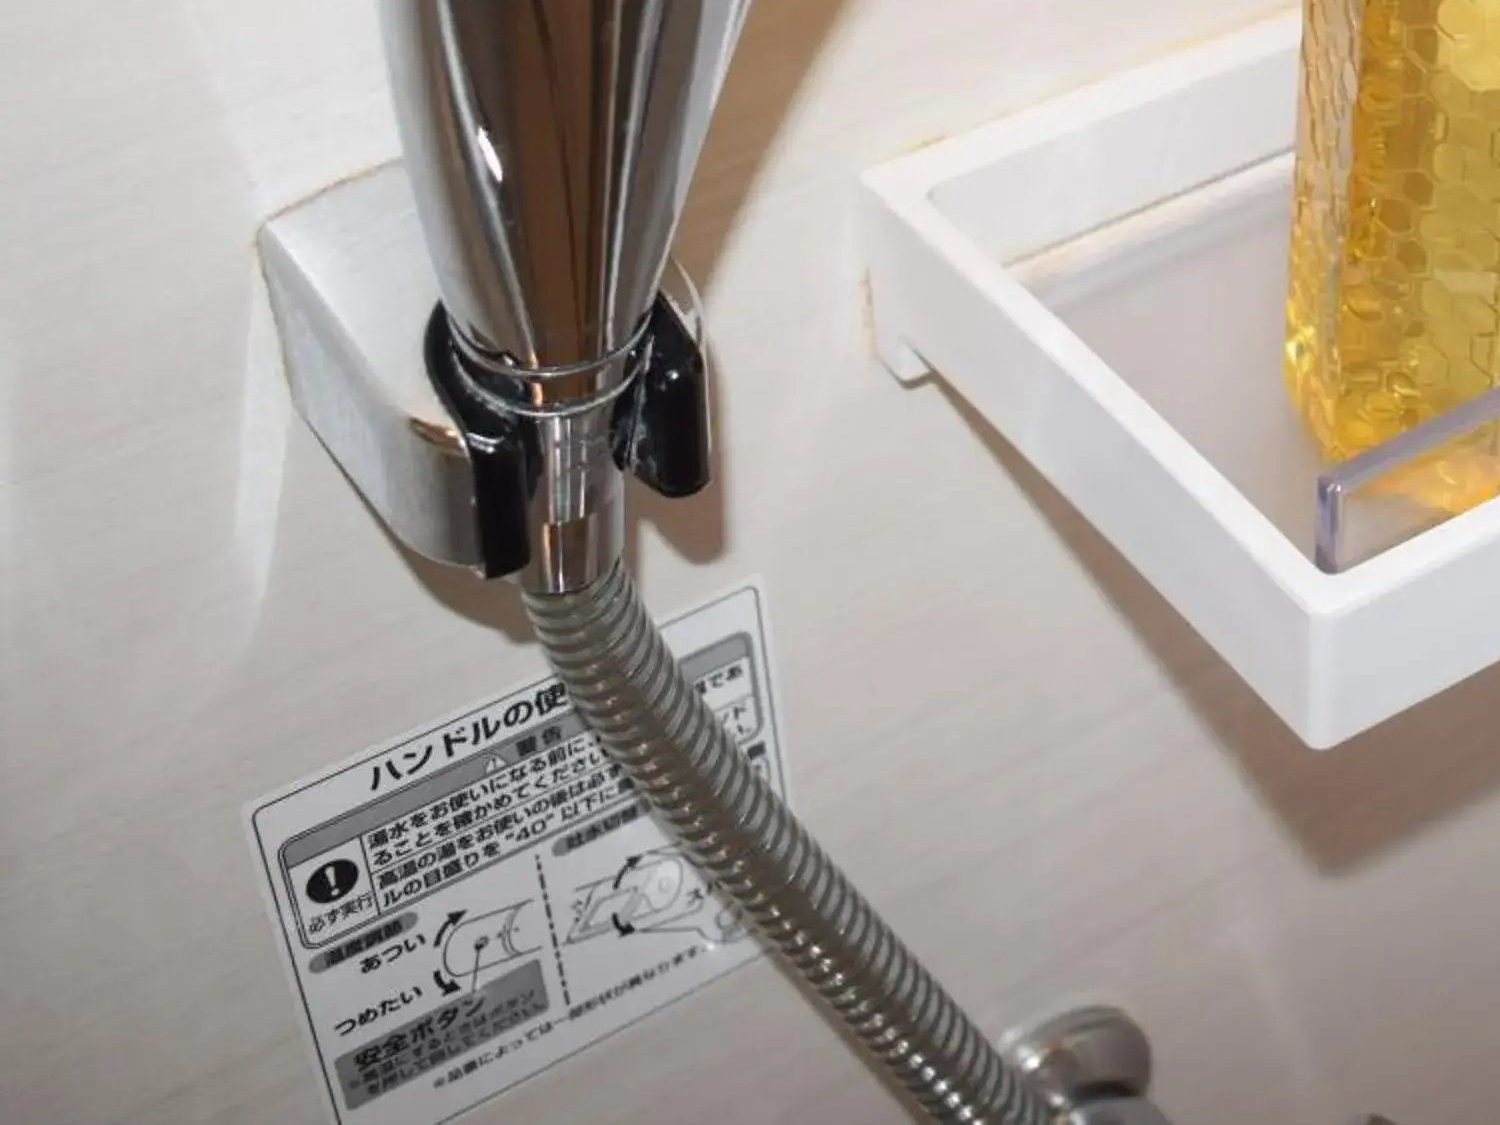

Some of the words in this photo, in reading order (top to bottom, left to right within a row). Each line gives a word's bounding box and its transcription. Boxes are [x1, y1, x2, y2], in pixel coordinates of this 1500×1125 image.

[368, 736, 602, 849] 湯水をお使いになる前に、
[360, 933, 427, 974] あつい
[334, 986, 423, 1037] つめたい
[354, 996, 485, 1072] 安全ボタン
